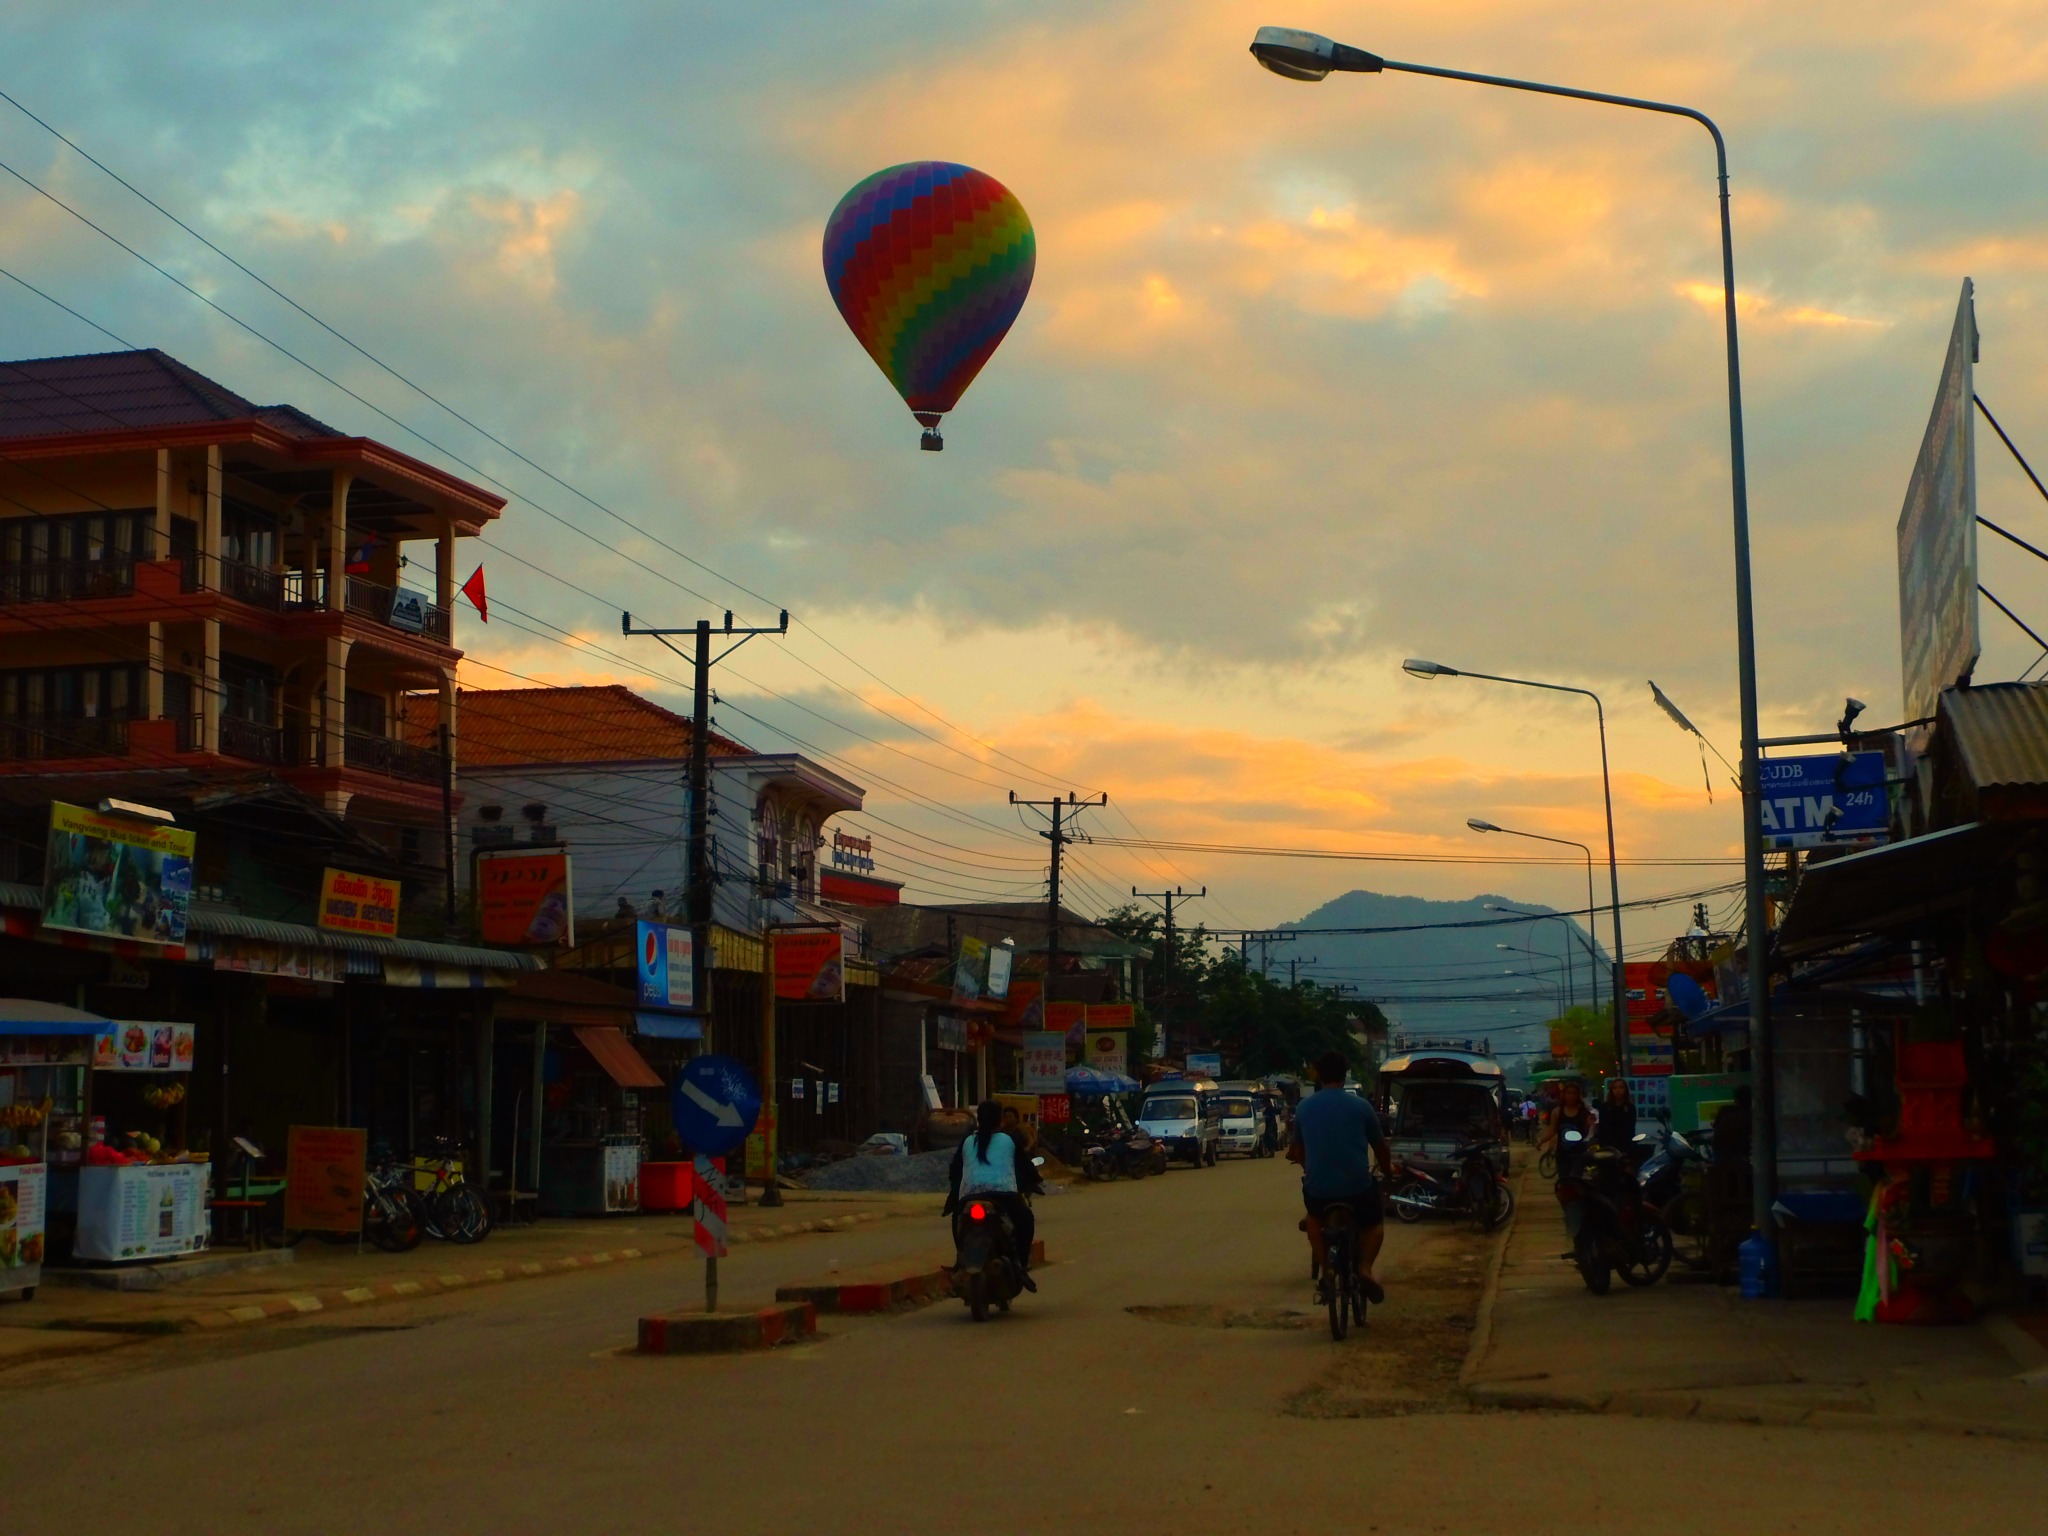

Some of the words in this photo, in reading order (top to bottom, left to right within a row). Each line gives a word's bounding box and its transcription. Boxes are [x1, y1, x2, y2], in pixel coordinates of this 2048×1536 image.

[1770, 764, 1804, 779] JDB
[1845, 791, 1874, 807] 24h
[1761, 795, 1834, 830] ATM
